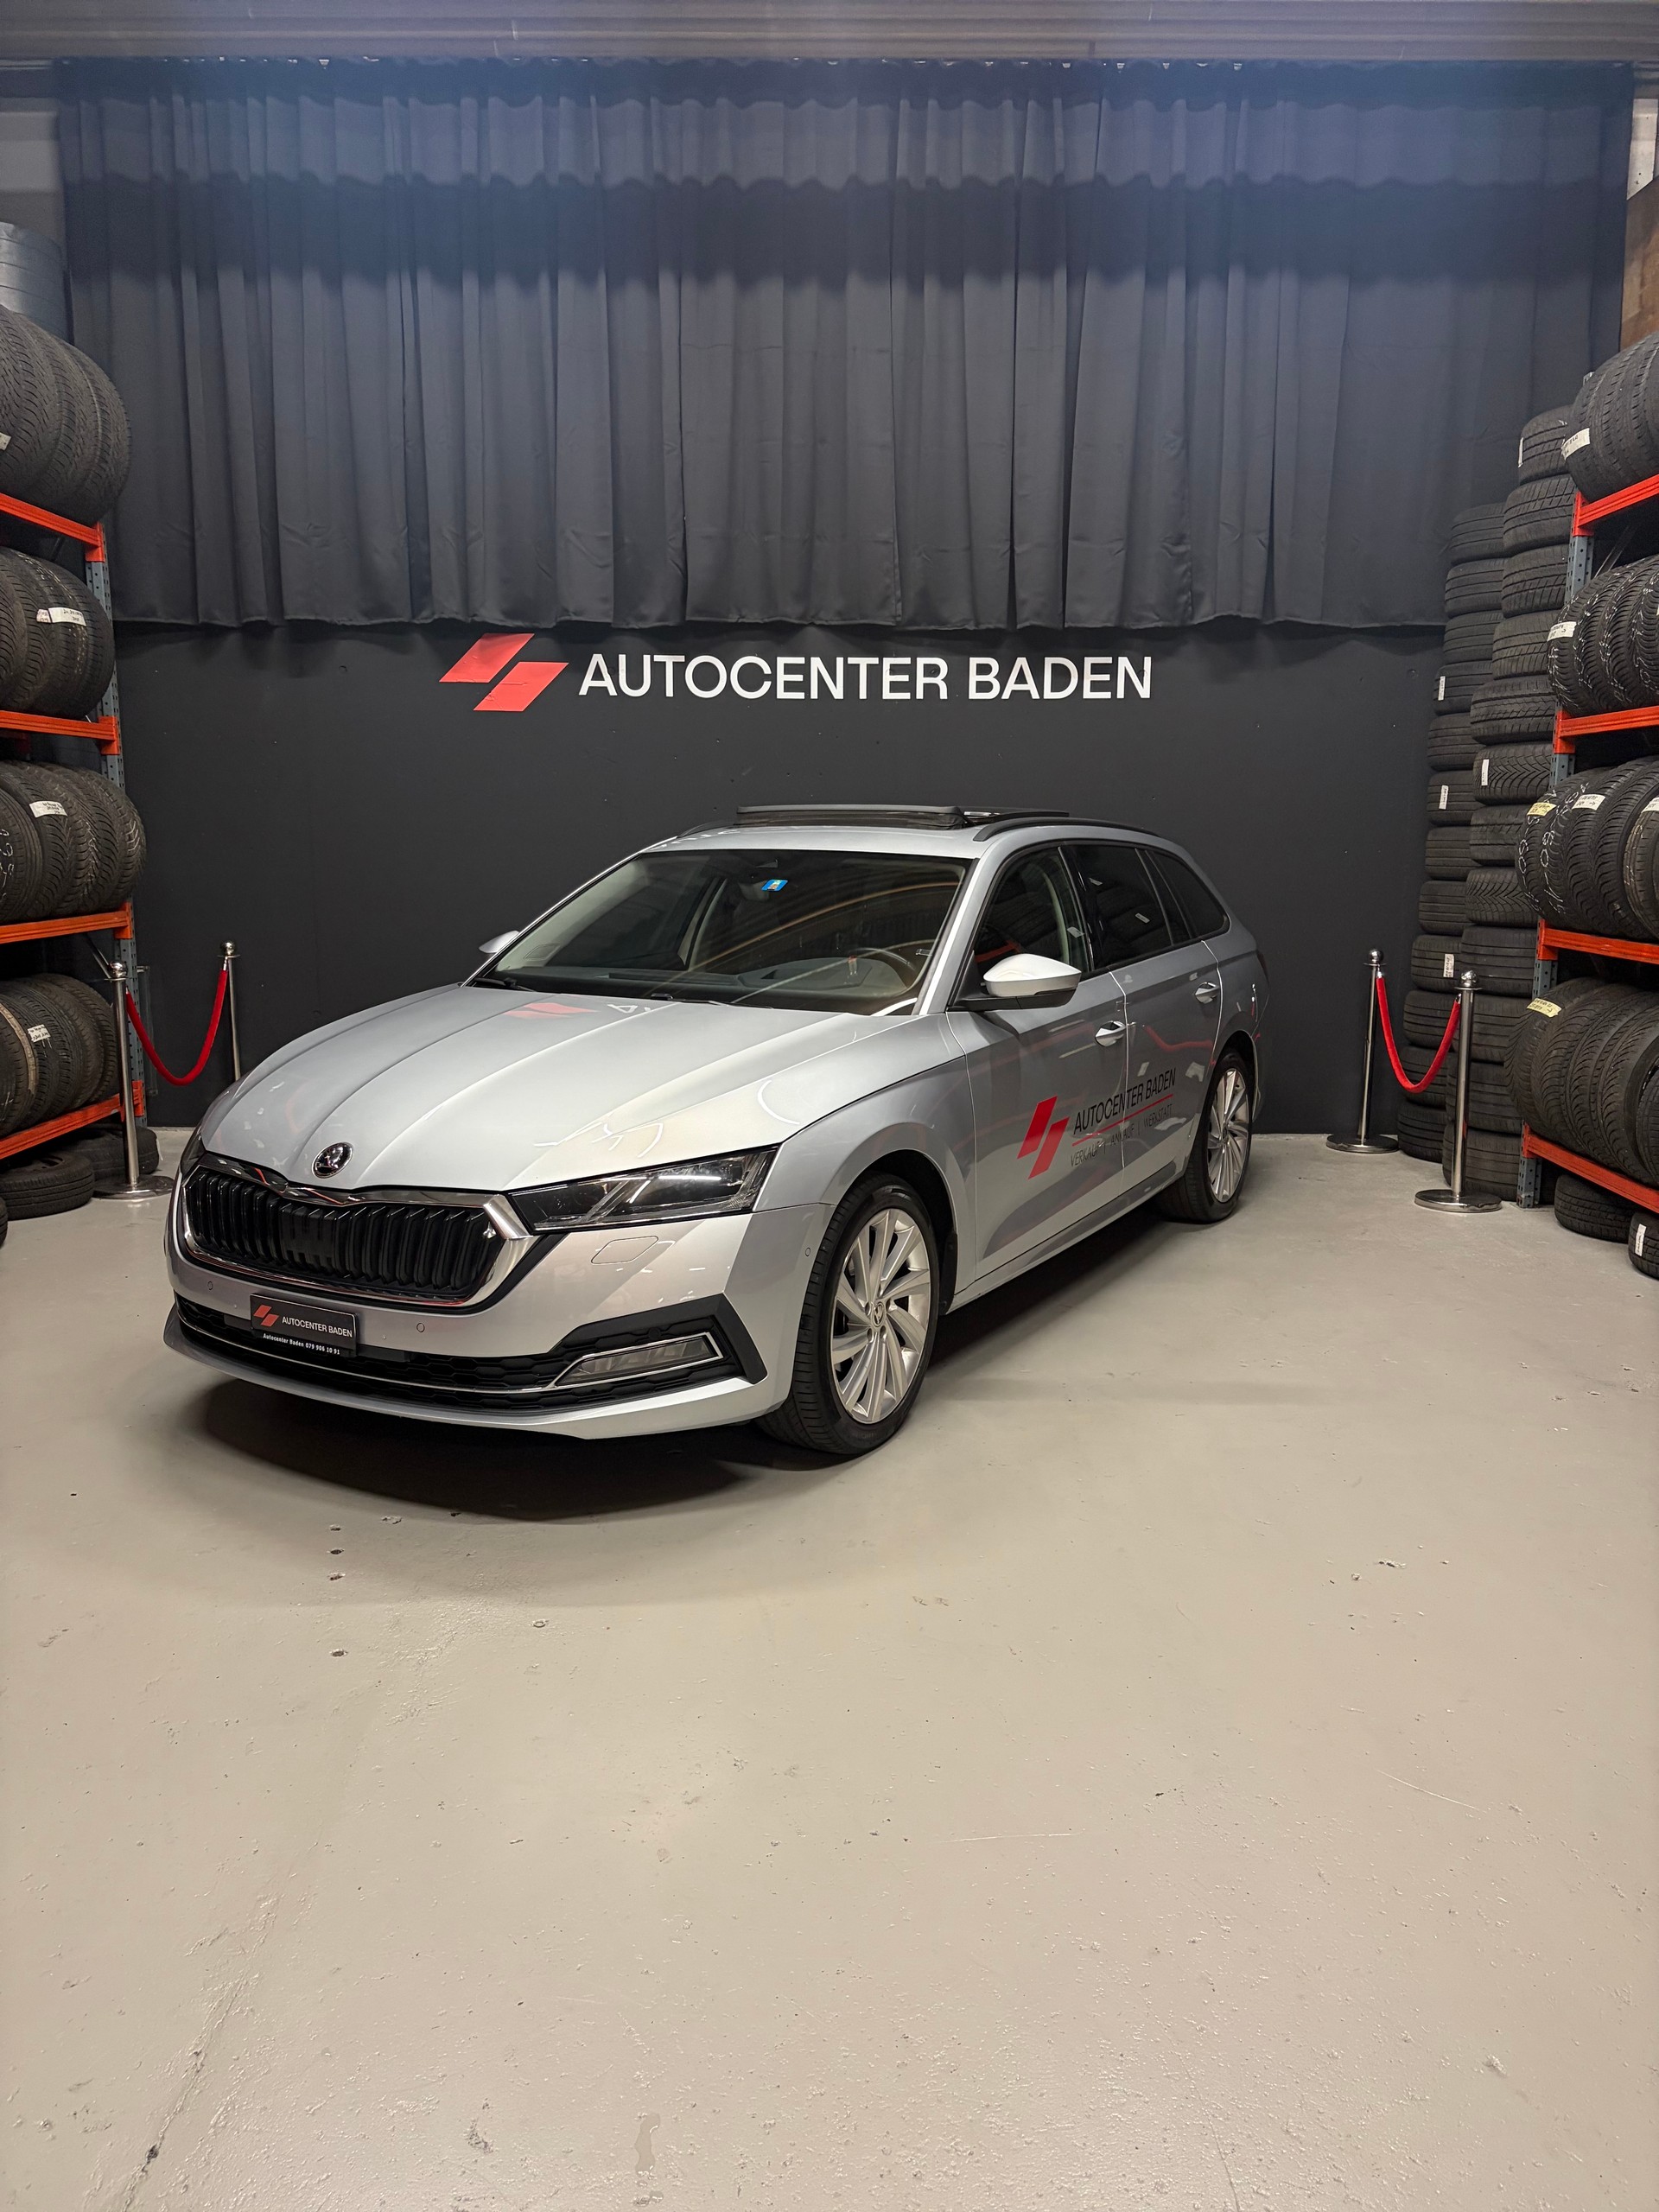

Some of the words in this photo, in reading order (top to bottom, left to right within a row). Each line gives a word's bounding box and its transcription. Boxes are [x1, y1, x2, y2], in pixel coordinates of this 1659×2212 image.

[580, 654, 948, 700] AUTOCENTER
[968, 655, 1153, 700] BADEN
[1073, 1083, 1143, 1135] AUTOCENTER
[1145, 1068, 1176, 1099] BADEN
[1070, 1141, 1101, 1167] VERKAUF
[1144, 1103, 1173, 1128] WERKSTATT
[263, 1332, 289, 1344] Autocenter
[289, 1338, 304, 1347] Baden
[282, 1316, 327, 1332] AUTOCENTER
[328, 1325, 353, 1338] BADEN
